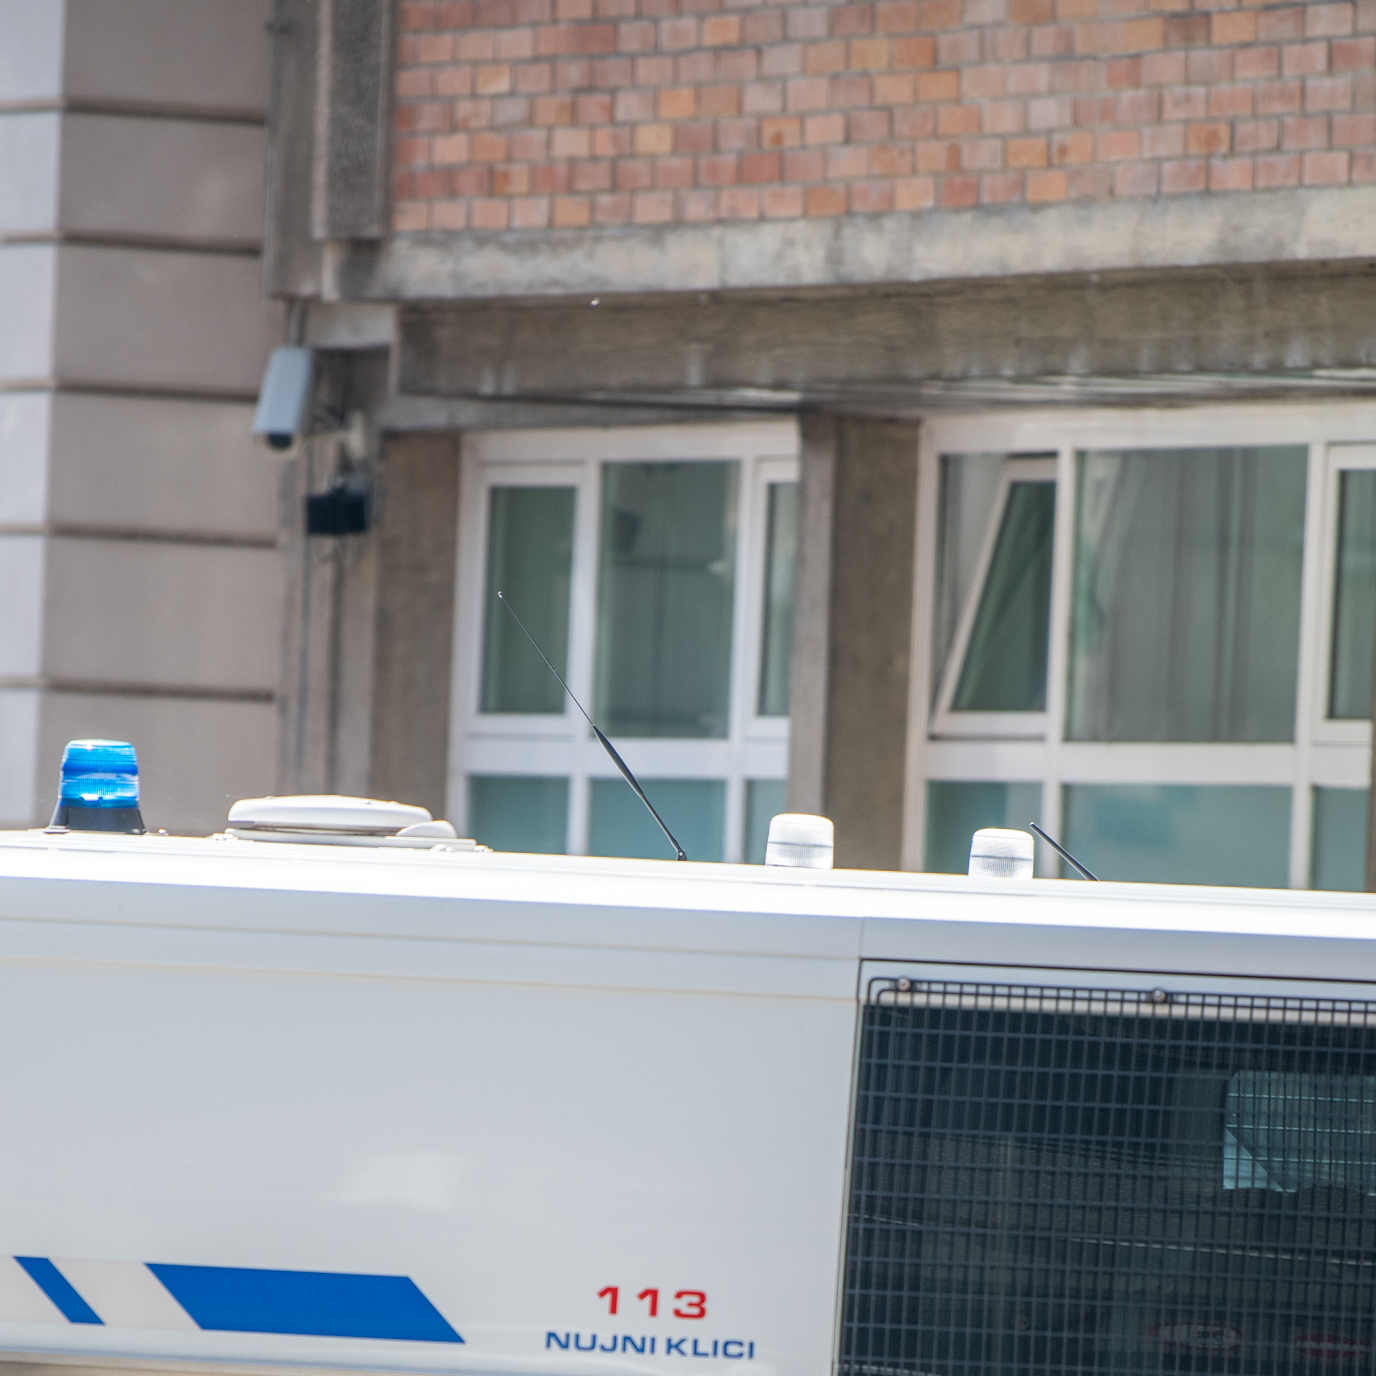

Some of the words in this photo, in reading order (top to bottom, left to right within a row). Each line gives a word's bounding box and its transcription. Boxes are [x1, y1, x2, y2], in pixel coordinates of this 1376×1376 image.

[596, 1285, 707, 1320] 113
[545, 1331, 656, 1355] NUJNI
[665, 1337, 755, 1360] KLICI
